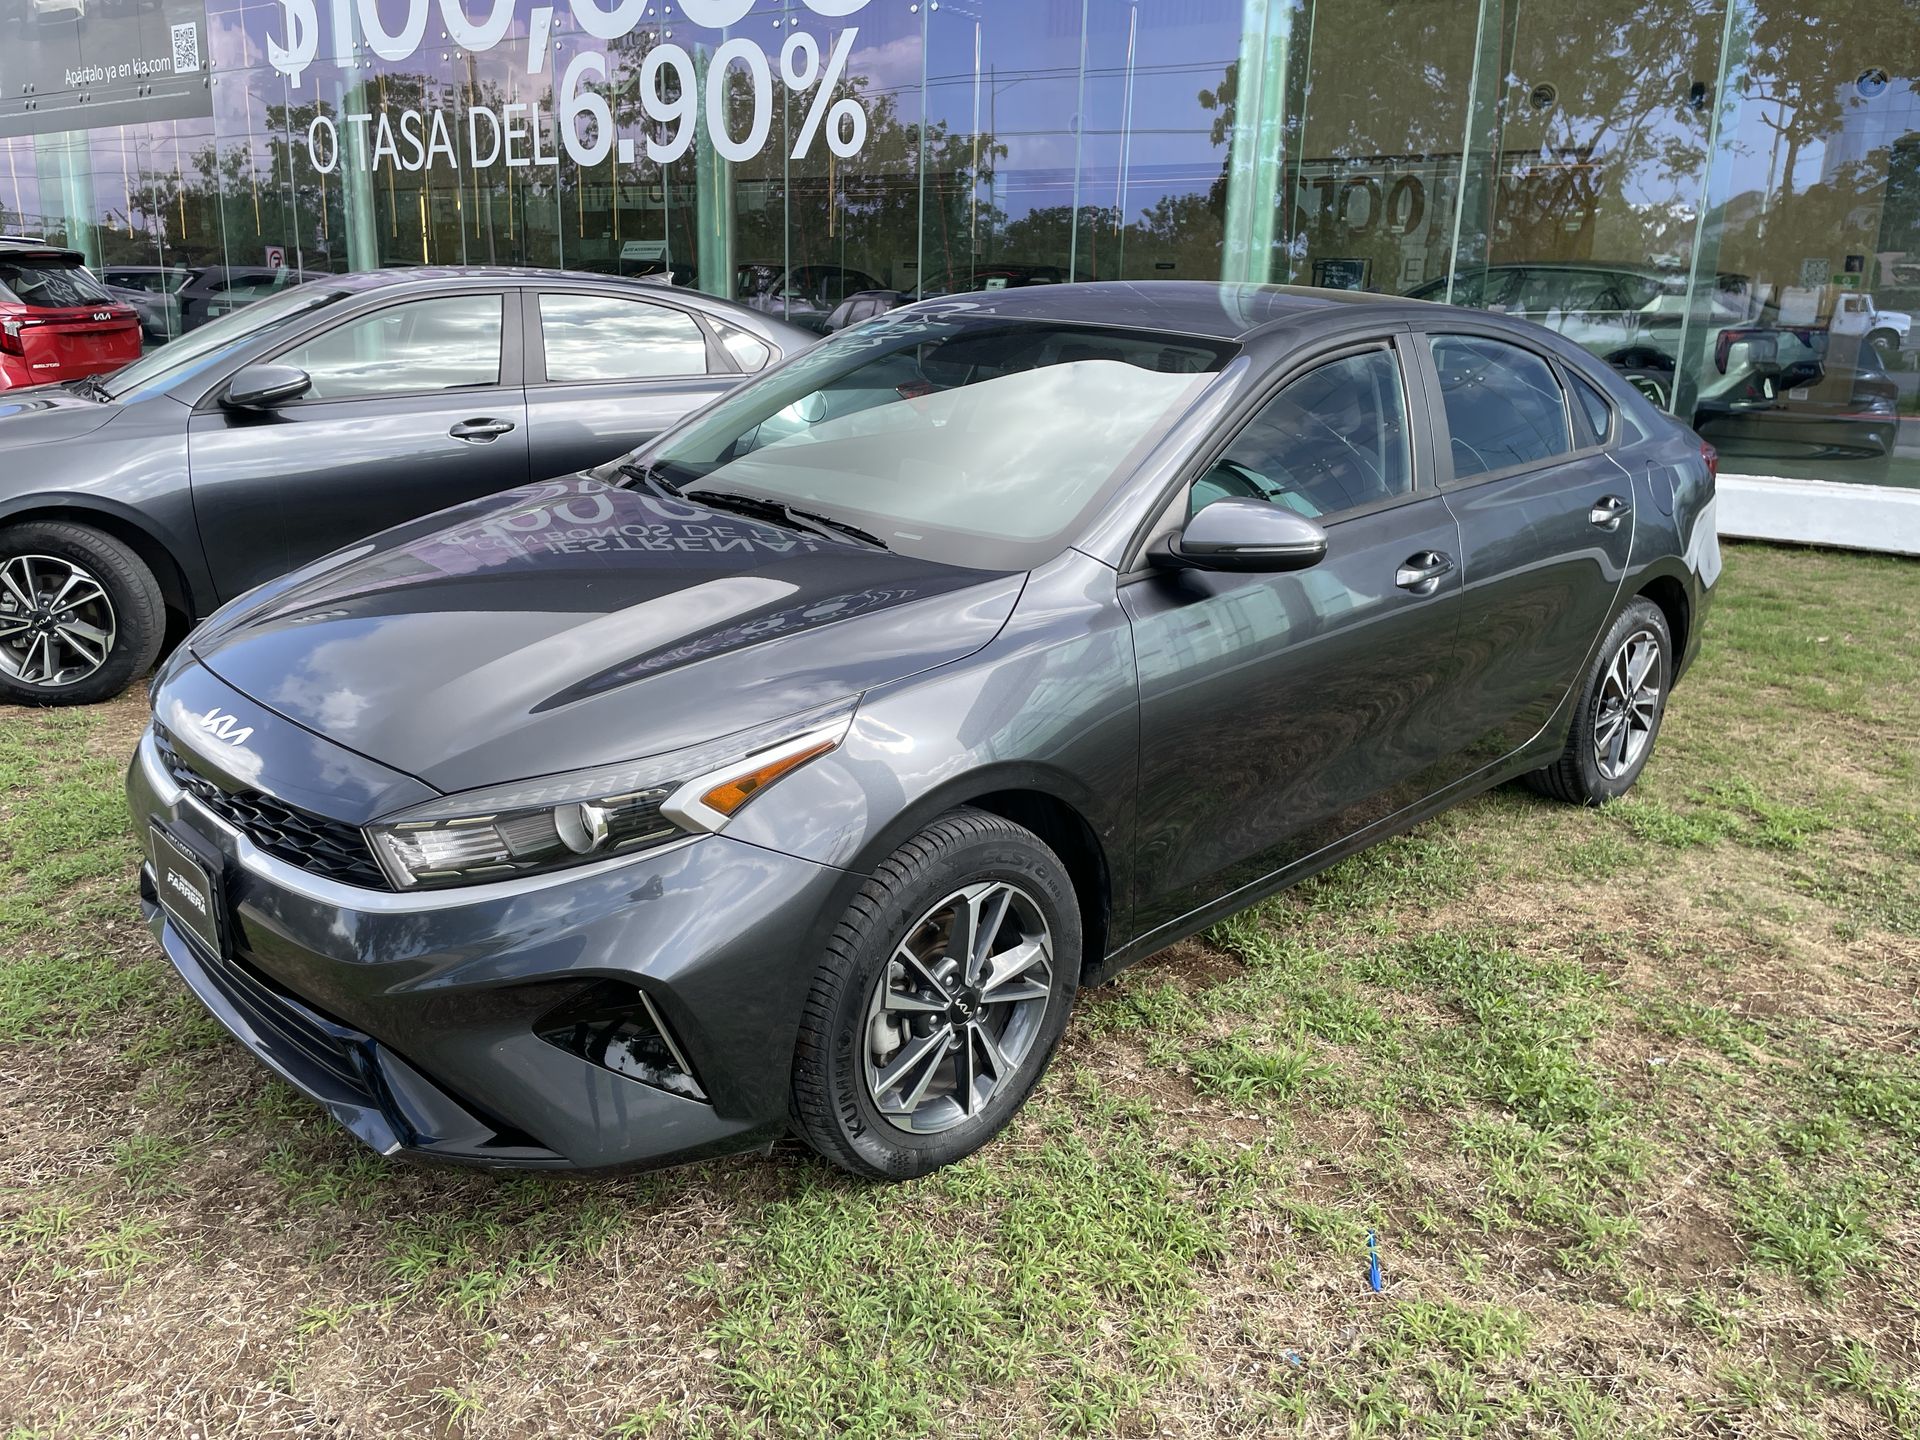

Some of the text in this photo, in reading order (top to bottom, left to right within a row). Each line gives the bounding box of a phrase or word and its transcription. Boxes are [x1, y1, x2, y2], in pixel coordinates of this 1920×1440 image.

[65, 57, 171, 88] Apártalo ya en kia.com
[308, 27, 867, 174] O TASA DEL 6.90%
[201, 707, 254, 746] KIA
[167, 871, 206, 916] FARRERA
